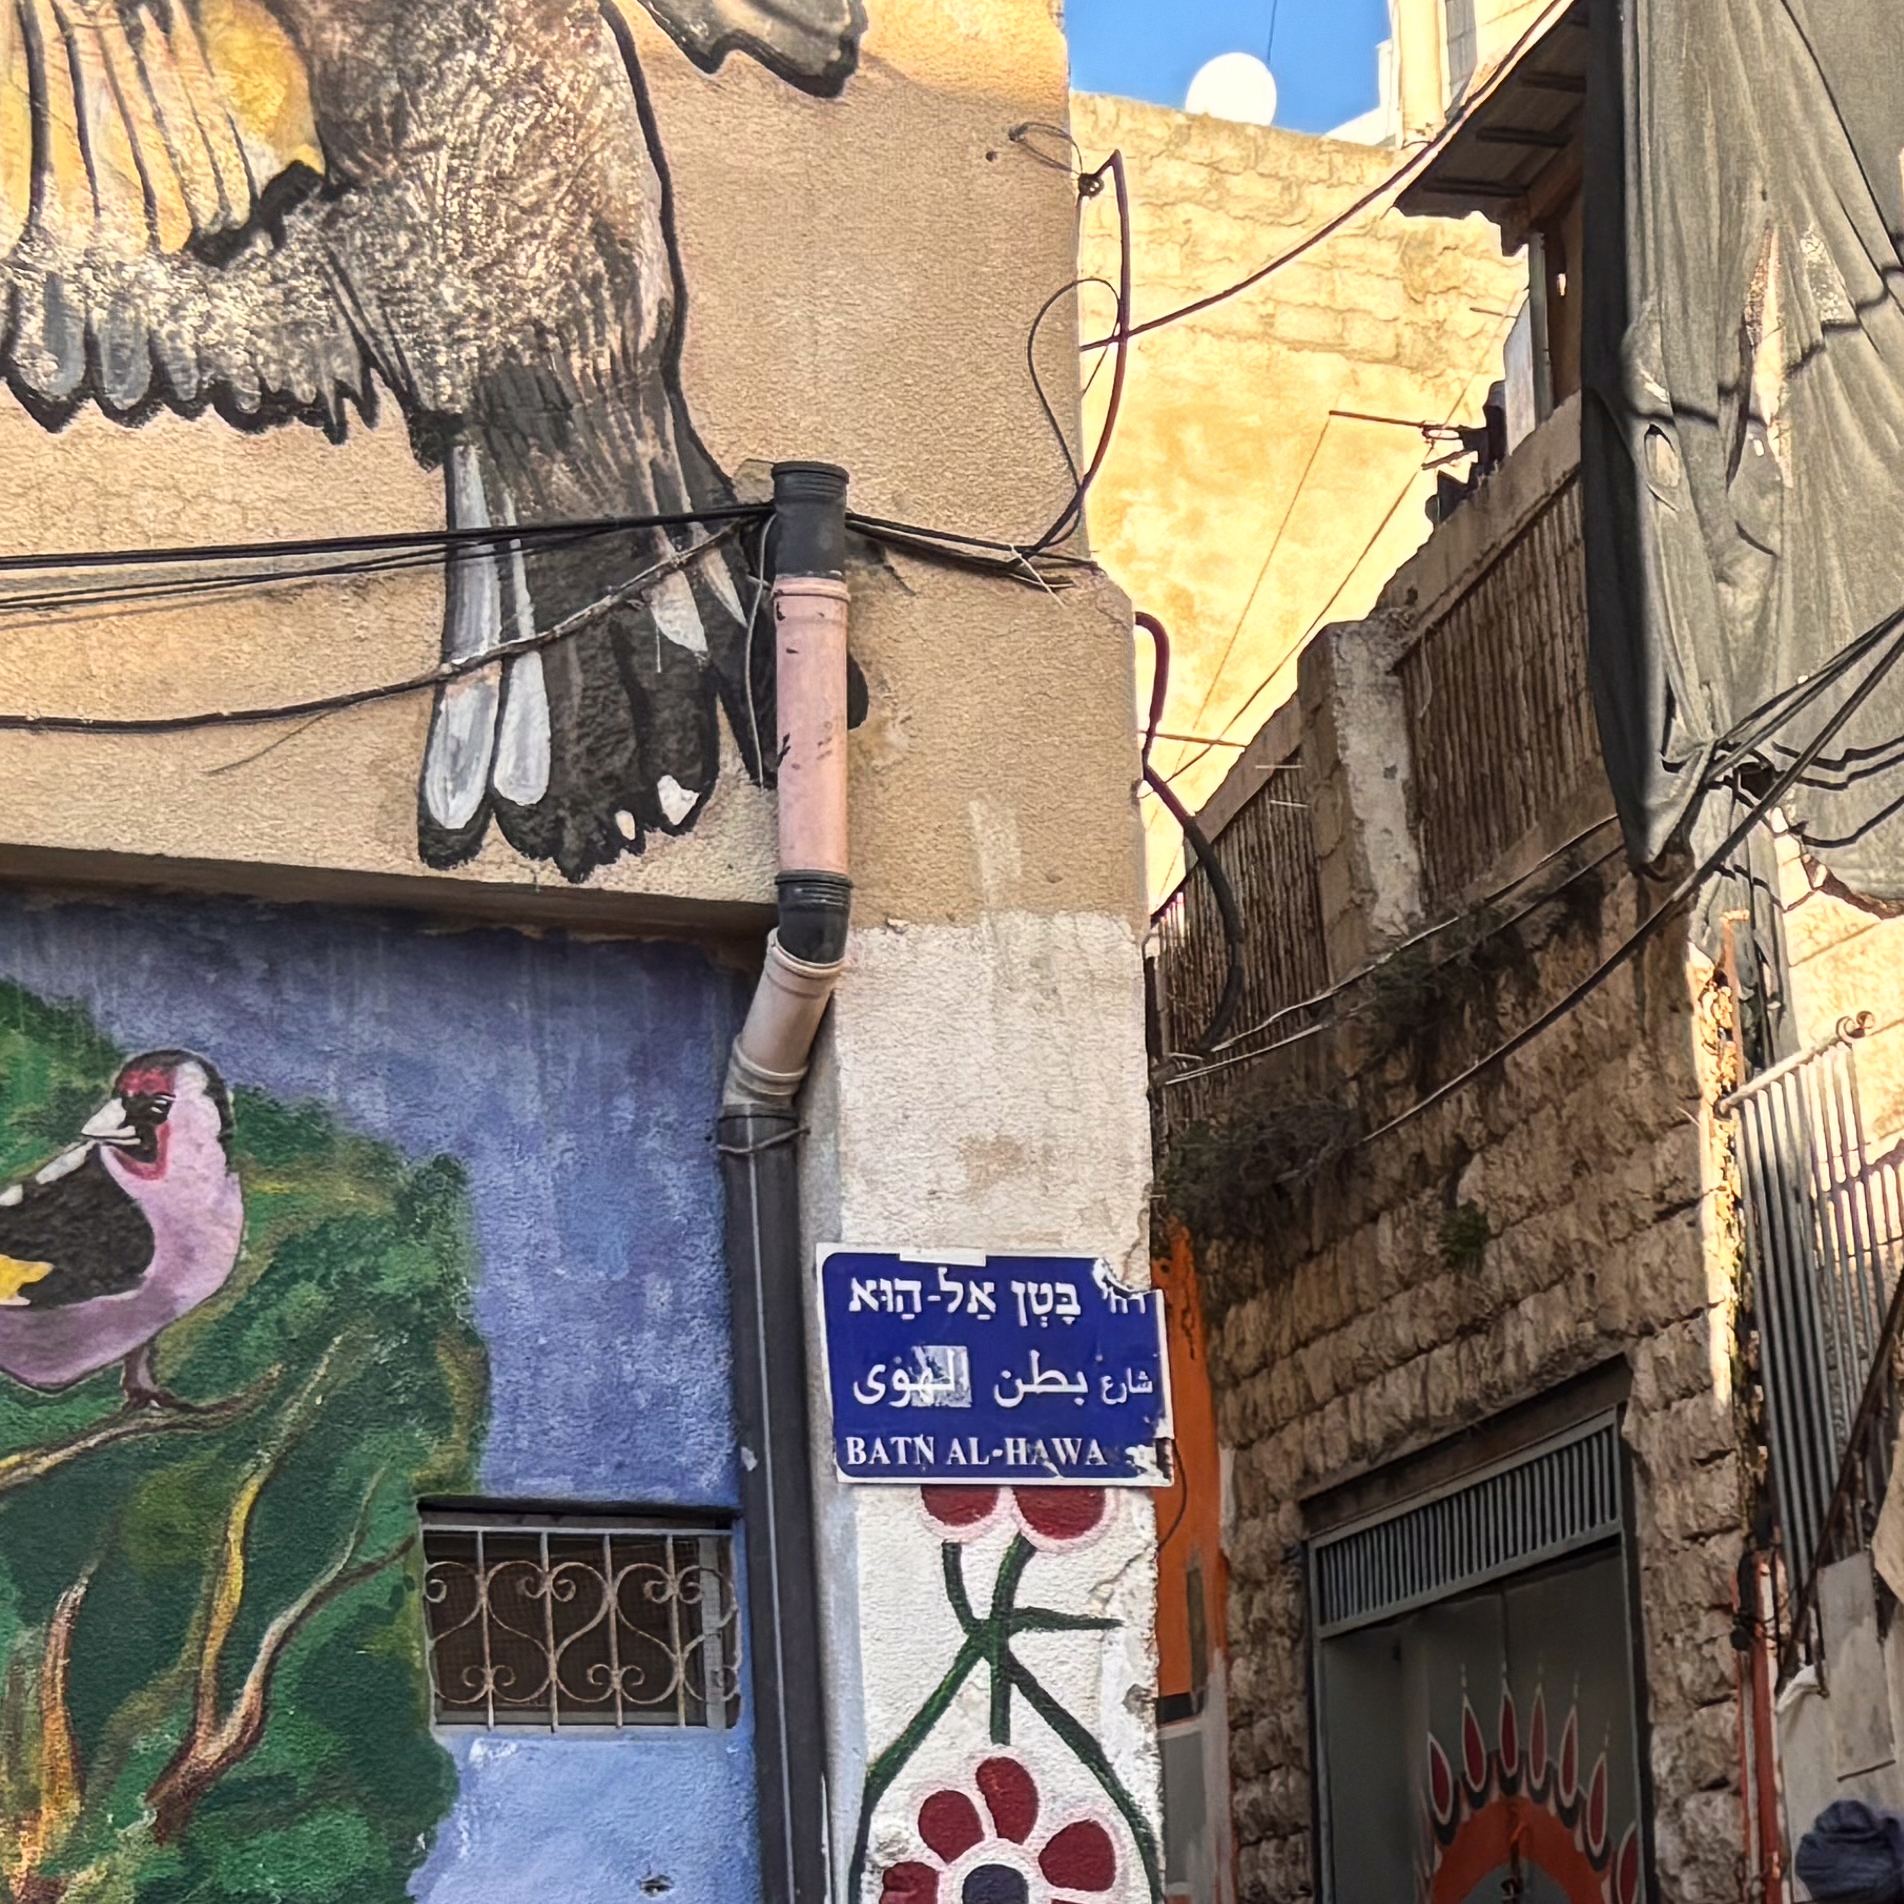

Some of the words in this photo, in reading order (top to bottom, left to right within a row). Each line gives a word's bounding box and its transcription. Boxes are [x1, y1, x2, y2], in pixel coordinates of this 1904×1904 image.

[853, 1348, 969, 1408] الهوى
[993, 1349, 1089, 1408] بطن
[1099, 1366, 1153, 1405] شارع
[845, 1436, 935, 1466] BATN
[946, 1436, 1108, 1466] AL-HAWA
